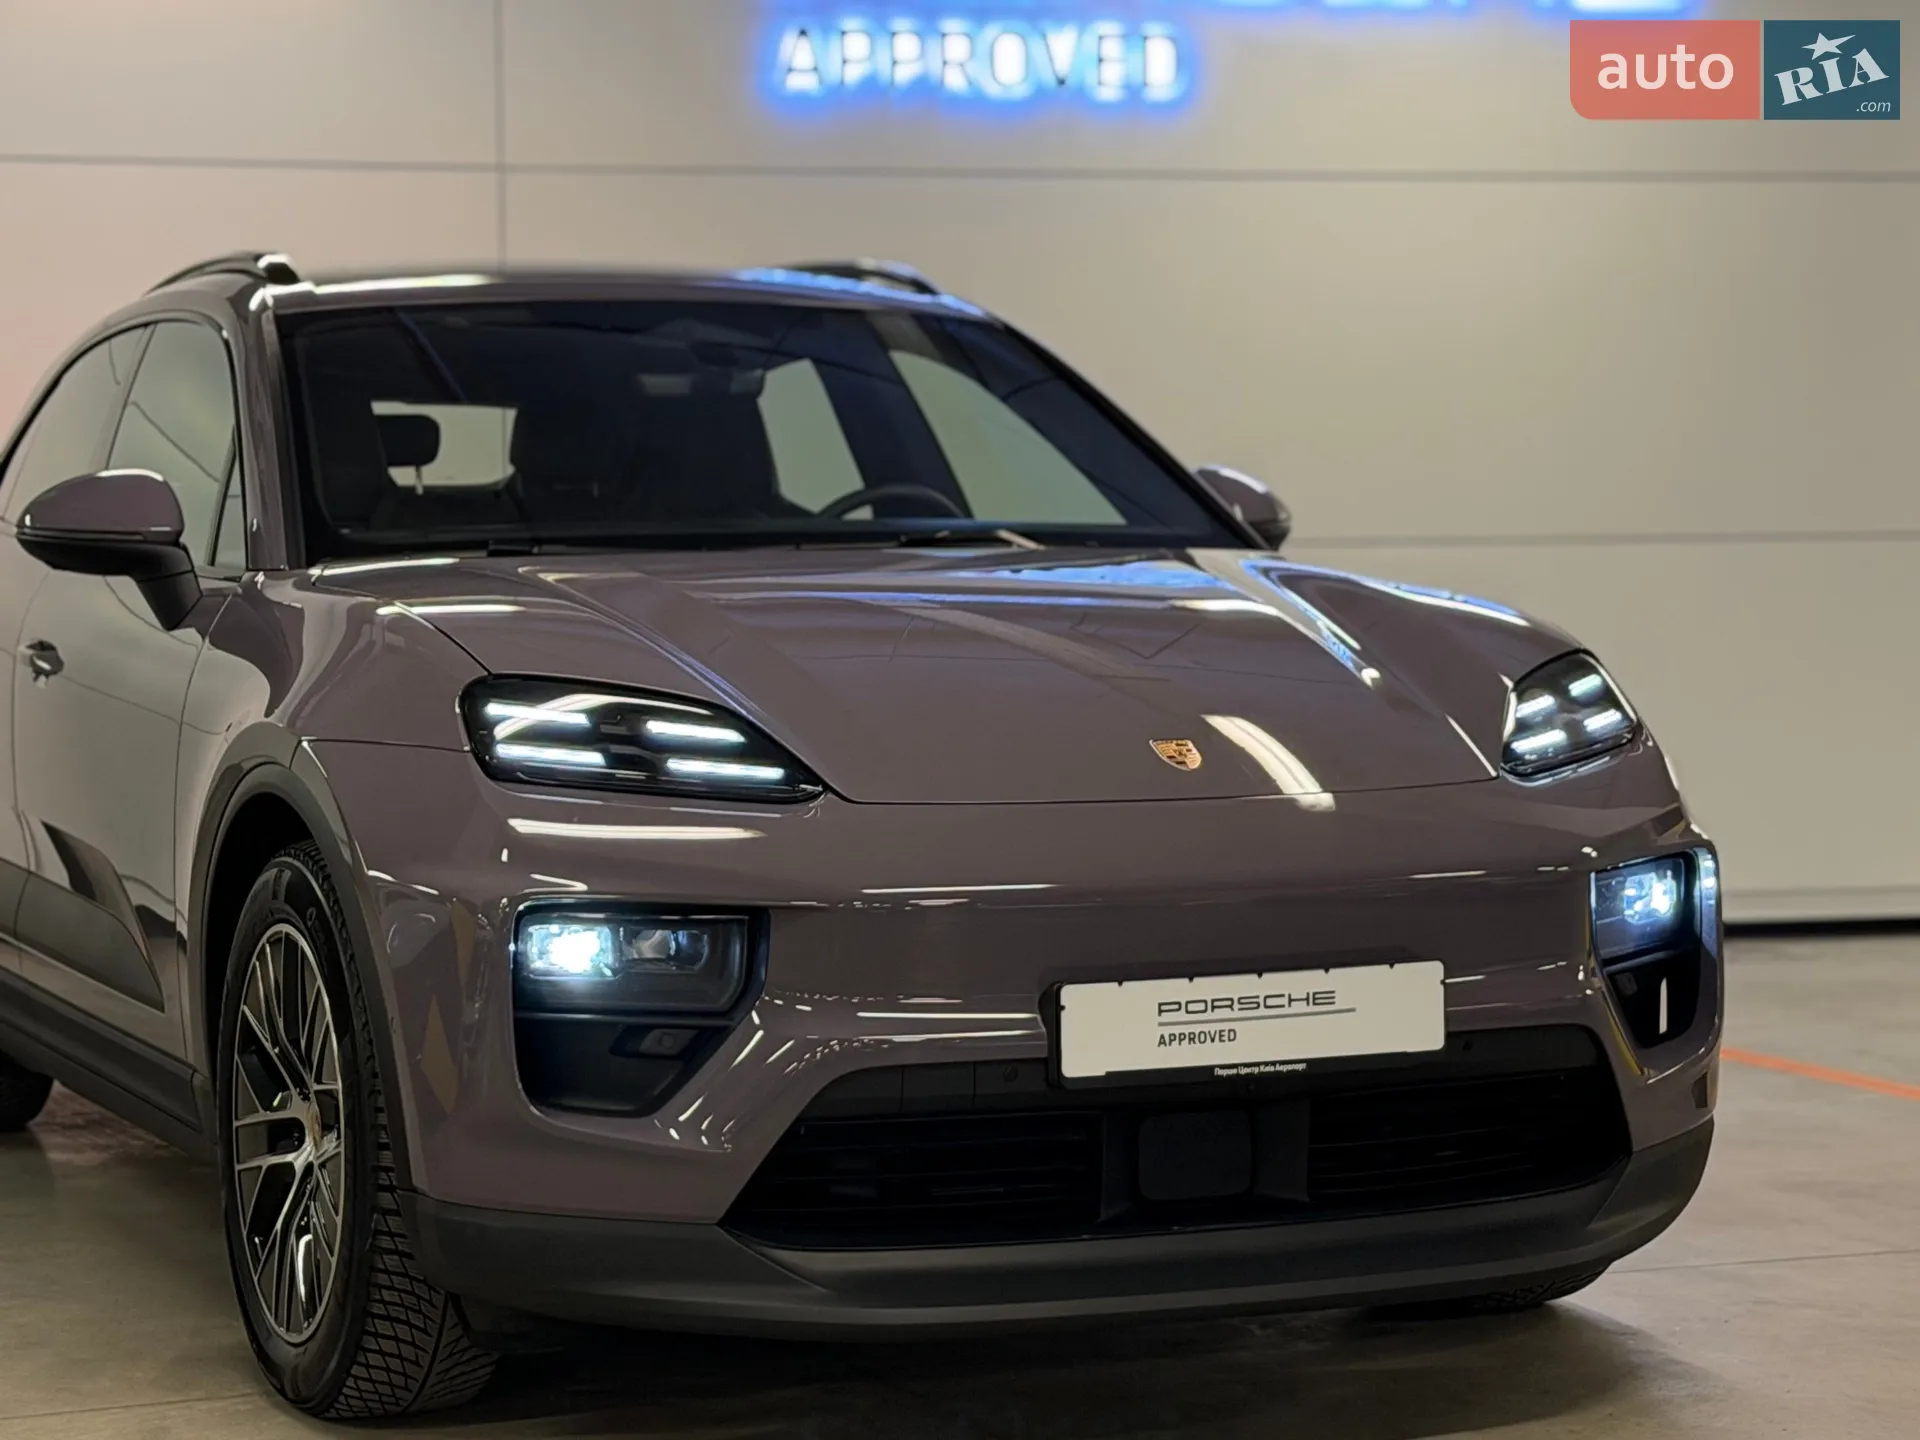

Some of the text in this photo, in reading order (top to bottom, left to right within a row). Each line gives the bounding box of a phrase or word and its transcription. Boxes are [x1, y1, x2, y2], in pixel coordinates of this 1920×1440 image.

[779, 22, 1187, 99] APPROVED
[1158, 990, 1336, 1017] PORSCHE
[1157, 1028, 1237, 1048] APPROVED
